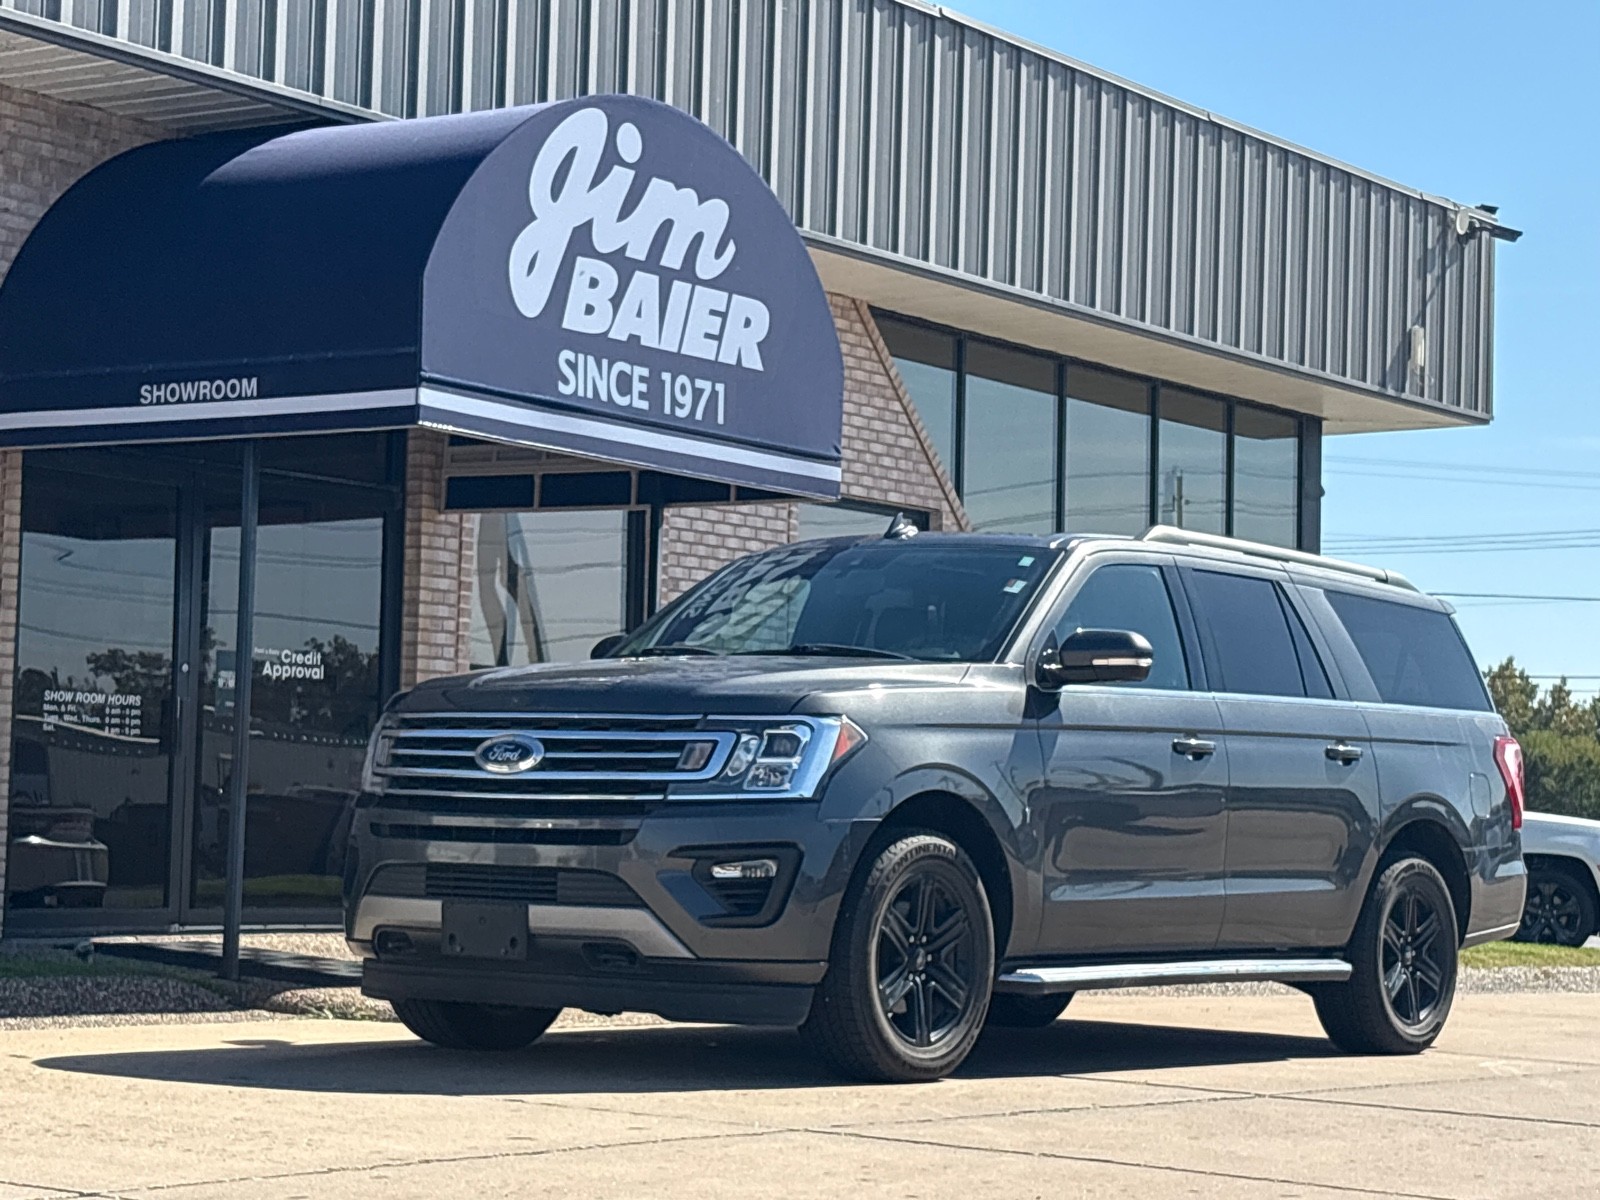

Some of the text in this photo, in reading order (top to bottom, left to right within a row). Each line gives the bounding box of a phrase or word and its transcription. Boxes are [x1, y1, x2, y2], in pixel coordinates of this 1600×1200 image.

[561, 256, 770, 371] BAIER
[139, 377, 258, 405] SHOWROOM
[558, 349, 726, 425] SINCE 1971
[281, 649, 322, 666] Credit
[262, 660, 325, 680] Approval
[44, 689, 142, 706] SHOW ROOM HOURS
[488, 744, 522, 761] Ford
[885, 842, 960, 883] CONTINENTA
